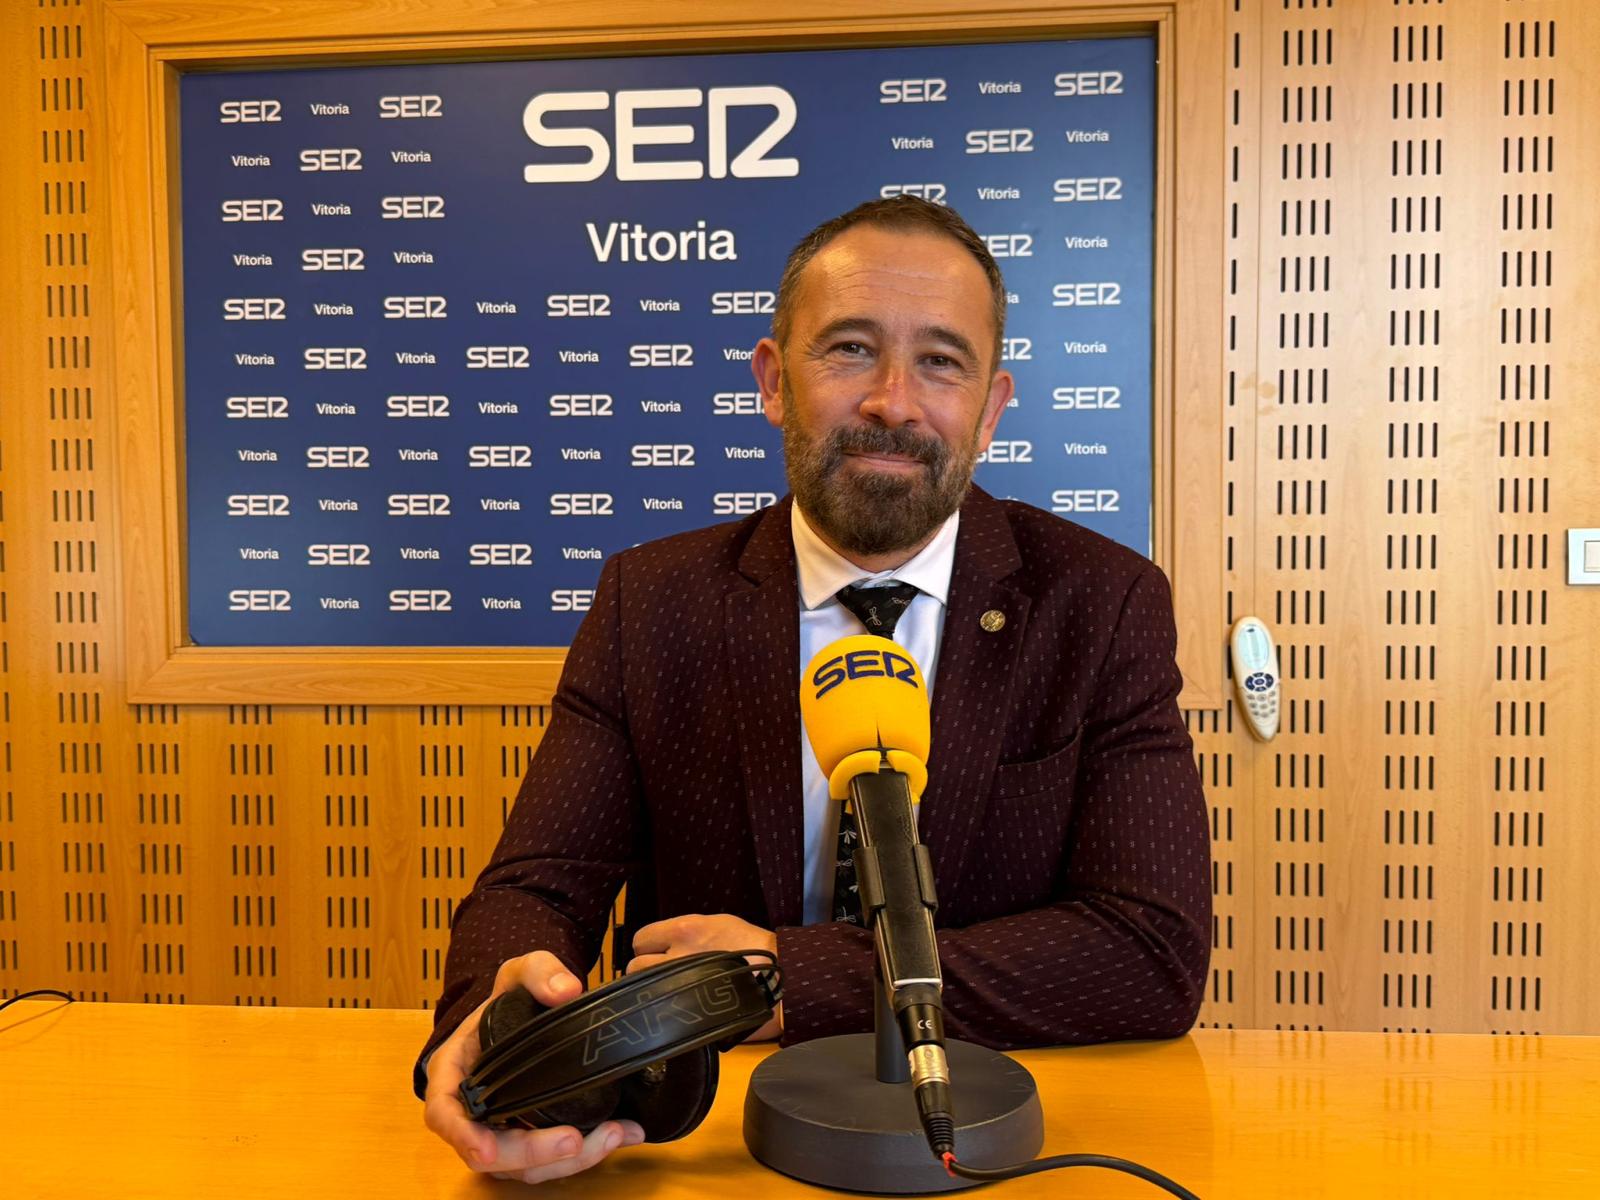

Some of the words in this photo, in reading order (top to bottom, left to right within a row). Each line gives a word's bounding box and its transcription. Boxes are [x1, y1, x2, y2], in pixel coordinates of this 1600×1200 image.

[880, 79, 946, 103] SER
[979, 81, 1021, 93] Vitoria
[1054, 72, 1123, 96] SER
[221, 101, 281, 123] SER
[311, 103, 349, 114] Vitoria
[380, 95, 442, 118] SER
[523, 86, 799, 183] SER
[892, 137, 933, 149] Vitoria
[966, 129, 1033, 153] SER
[1066, 130, 1109, 142] Vitoria
[232, 155, 270, 166] Vitoria
[300, 149, 362, 171] SER
[392, 150, 431, 162] Vitoria
[978, 187, 1019, 199] Vitoria
[1054, 177, 1122, 202] SER
[222, 200, 283, 221] SER
[312, 203, 351, 215] Vitoria
[382, 196, 444, 218] SER
[587, 221, 737, 262] Vitoria
[979, 234, 1033, 257] ER
[1065, 235, 1108, 248] Vitoria
[234, 254, 272, 265] Vitoria
[302, 249, 364, 270] SER
[394, 251, 433, 263] Vitoria
[711, 291, 776, 315] SER
[1052, 282, 1121, 306] SER
[224, 299, 285, 320] SER
[315, 303, 353, 315] Vitoria
[384, 297, 447, 318] SER
[477, 301, 516, 313] Vitoria
[548, 295, 610, 316] SER
[640, 299, 680, 311] Vitoria
[559, 350, 599, 362] Vitoria
[630, 345, 693, 366] SER
[723, 348, 755, 360] Vitor
[1064, 340, 1108, 353] Vitoria
[236, 353, 274, 365] Vitoria
[305, 348, 367, 369] SER
[396, 352, 435, 363] Vitoria
[467, 347, 529, 368] SER
[227, 397, 288, 417] SER
[387, 396, 449, 417] SER
[479, 402, 518, 413] Vitoria
[550, 395, 612, 416] SER
[642, 400, 681, 412] Vitoria
[1053, 386, 1121, 409] SER
[317, 403, 355, 414] Vitoria
[239, 449, 277, 461] Vitoria
[307, 447, 369, 467] SER
[399, 449, 438, 460] Vitoria
[469, 446, 531, 467] SER
[562, 448, 601, 459] Vitoria
[632, 445, 694, 466] SER
[725, 447, 765, 458] Vitoria
[976, 440, 1033, 463] ER
[1064, 442, 1107, 454] Vitoria
[228, 495, 289, 515] SER
[319, 499, 358, 510] Vitoria
[388, 495, 450, 515] SER
[481, 498, 520, 510] Vitoria
[551, 494, 613, 514] SER
[643, 498, 682, 509] Vitoria
[1052, 490, 1120, 512] SER
[240, 548, 279, 559] Vitoria
[308, 545, 370, 565] SER
[401, 547, 439, 559] Vitoria
[470, 544, 532, 565] SER
[563, 547, 602, 559] Vitoria
[229, 590, 291, 610] SER
[321, 597, 359, 609] Vitoria
[390, 590, 451, 610] SER
[482, 597, 521, 609] Vitoria
[551, 590, 596, 611] SE
[813, 650, 918, 700] SER
[582, 968, 740, 1066] AKG
